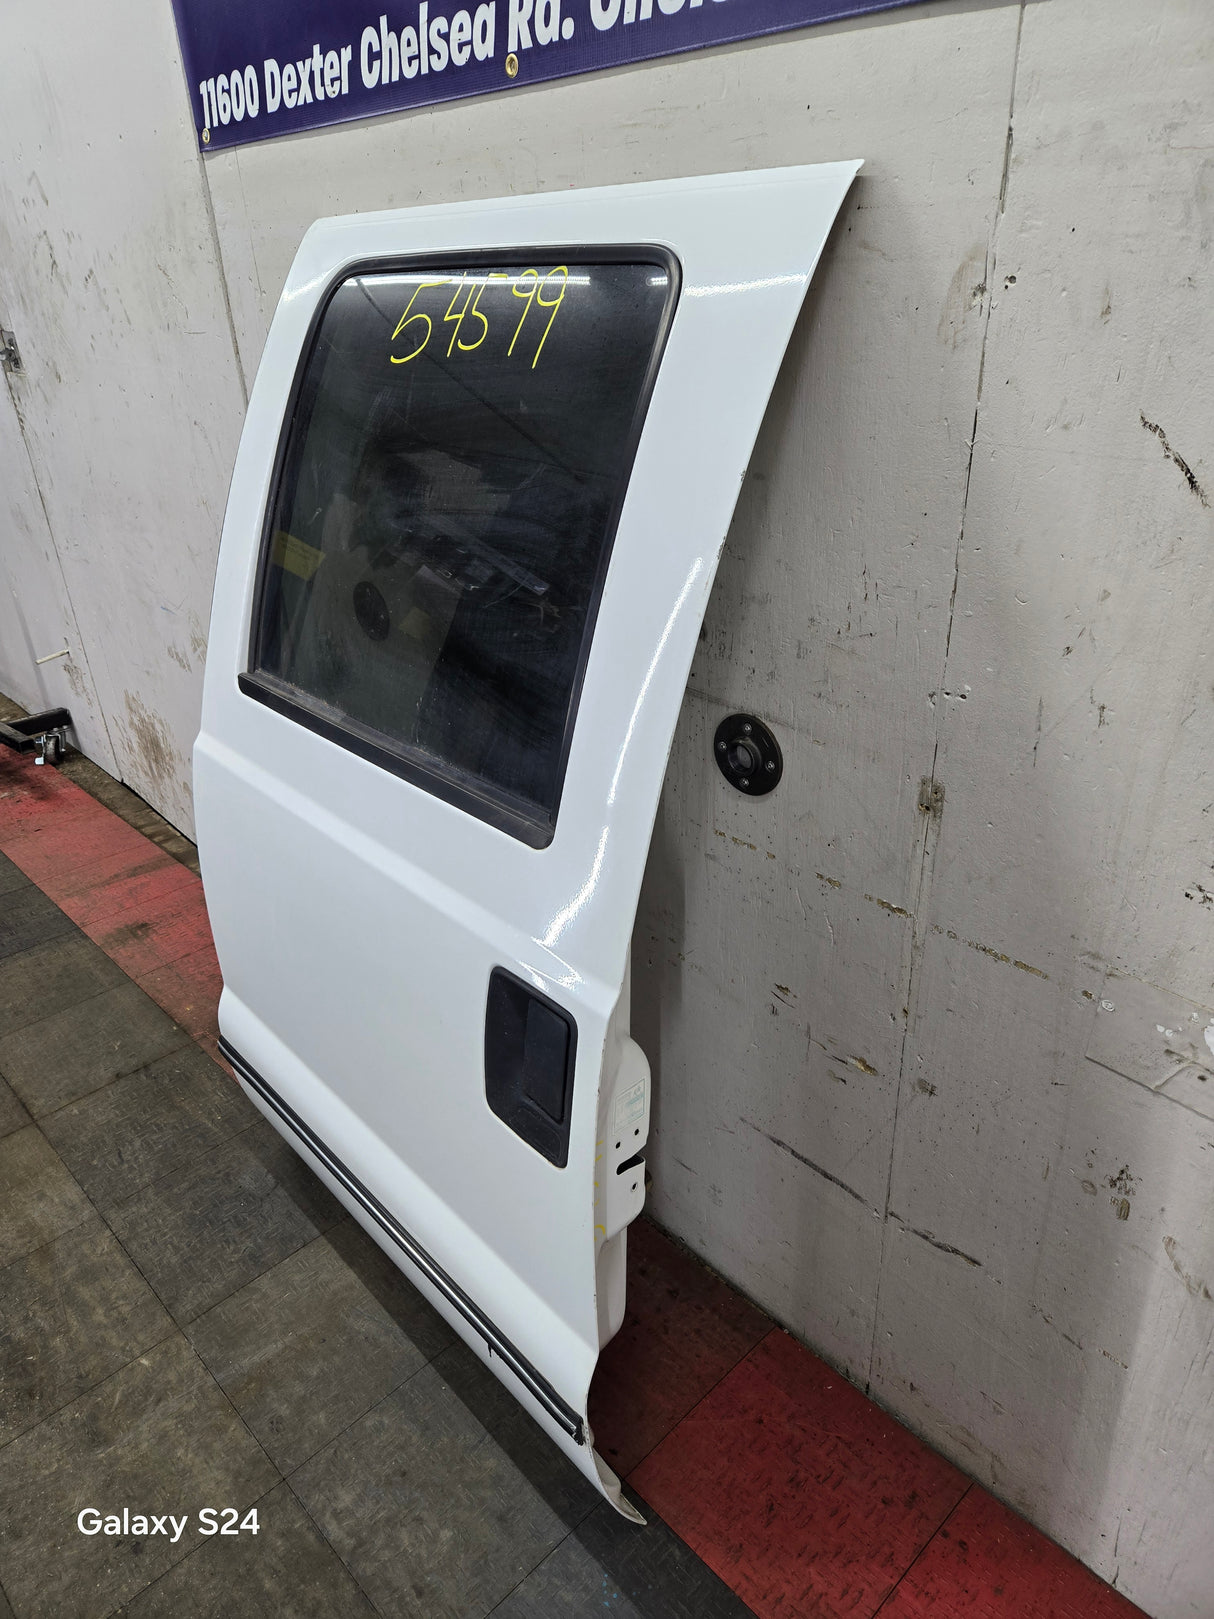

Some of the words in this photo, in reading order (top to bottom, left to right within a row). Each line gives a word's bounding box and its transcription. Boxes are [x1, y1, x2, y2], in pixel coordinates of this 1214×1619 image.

[200, 65, 259, 128] 11600
[264, 44, 351, 113] Dexter
[360, 1, 495, 89] Chelsea
[390, 265, 568, 369] 54599
